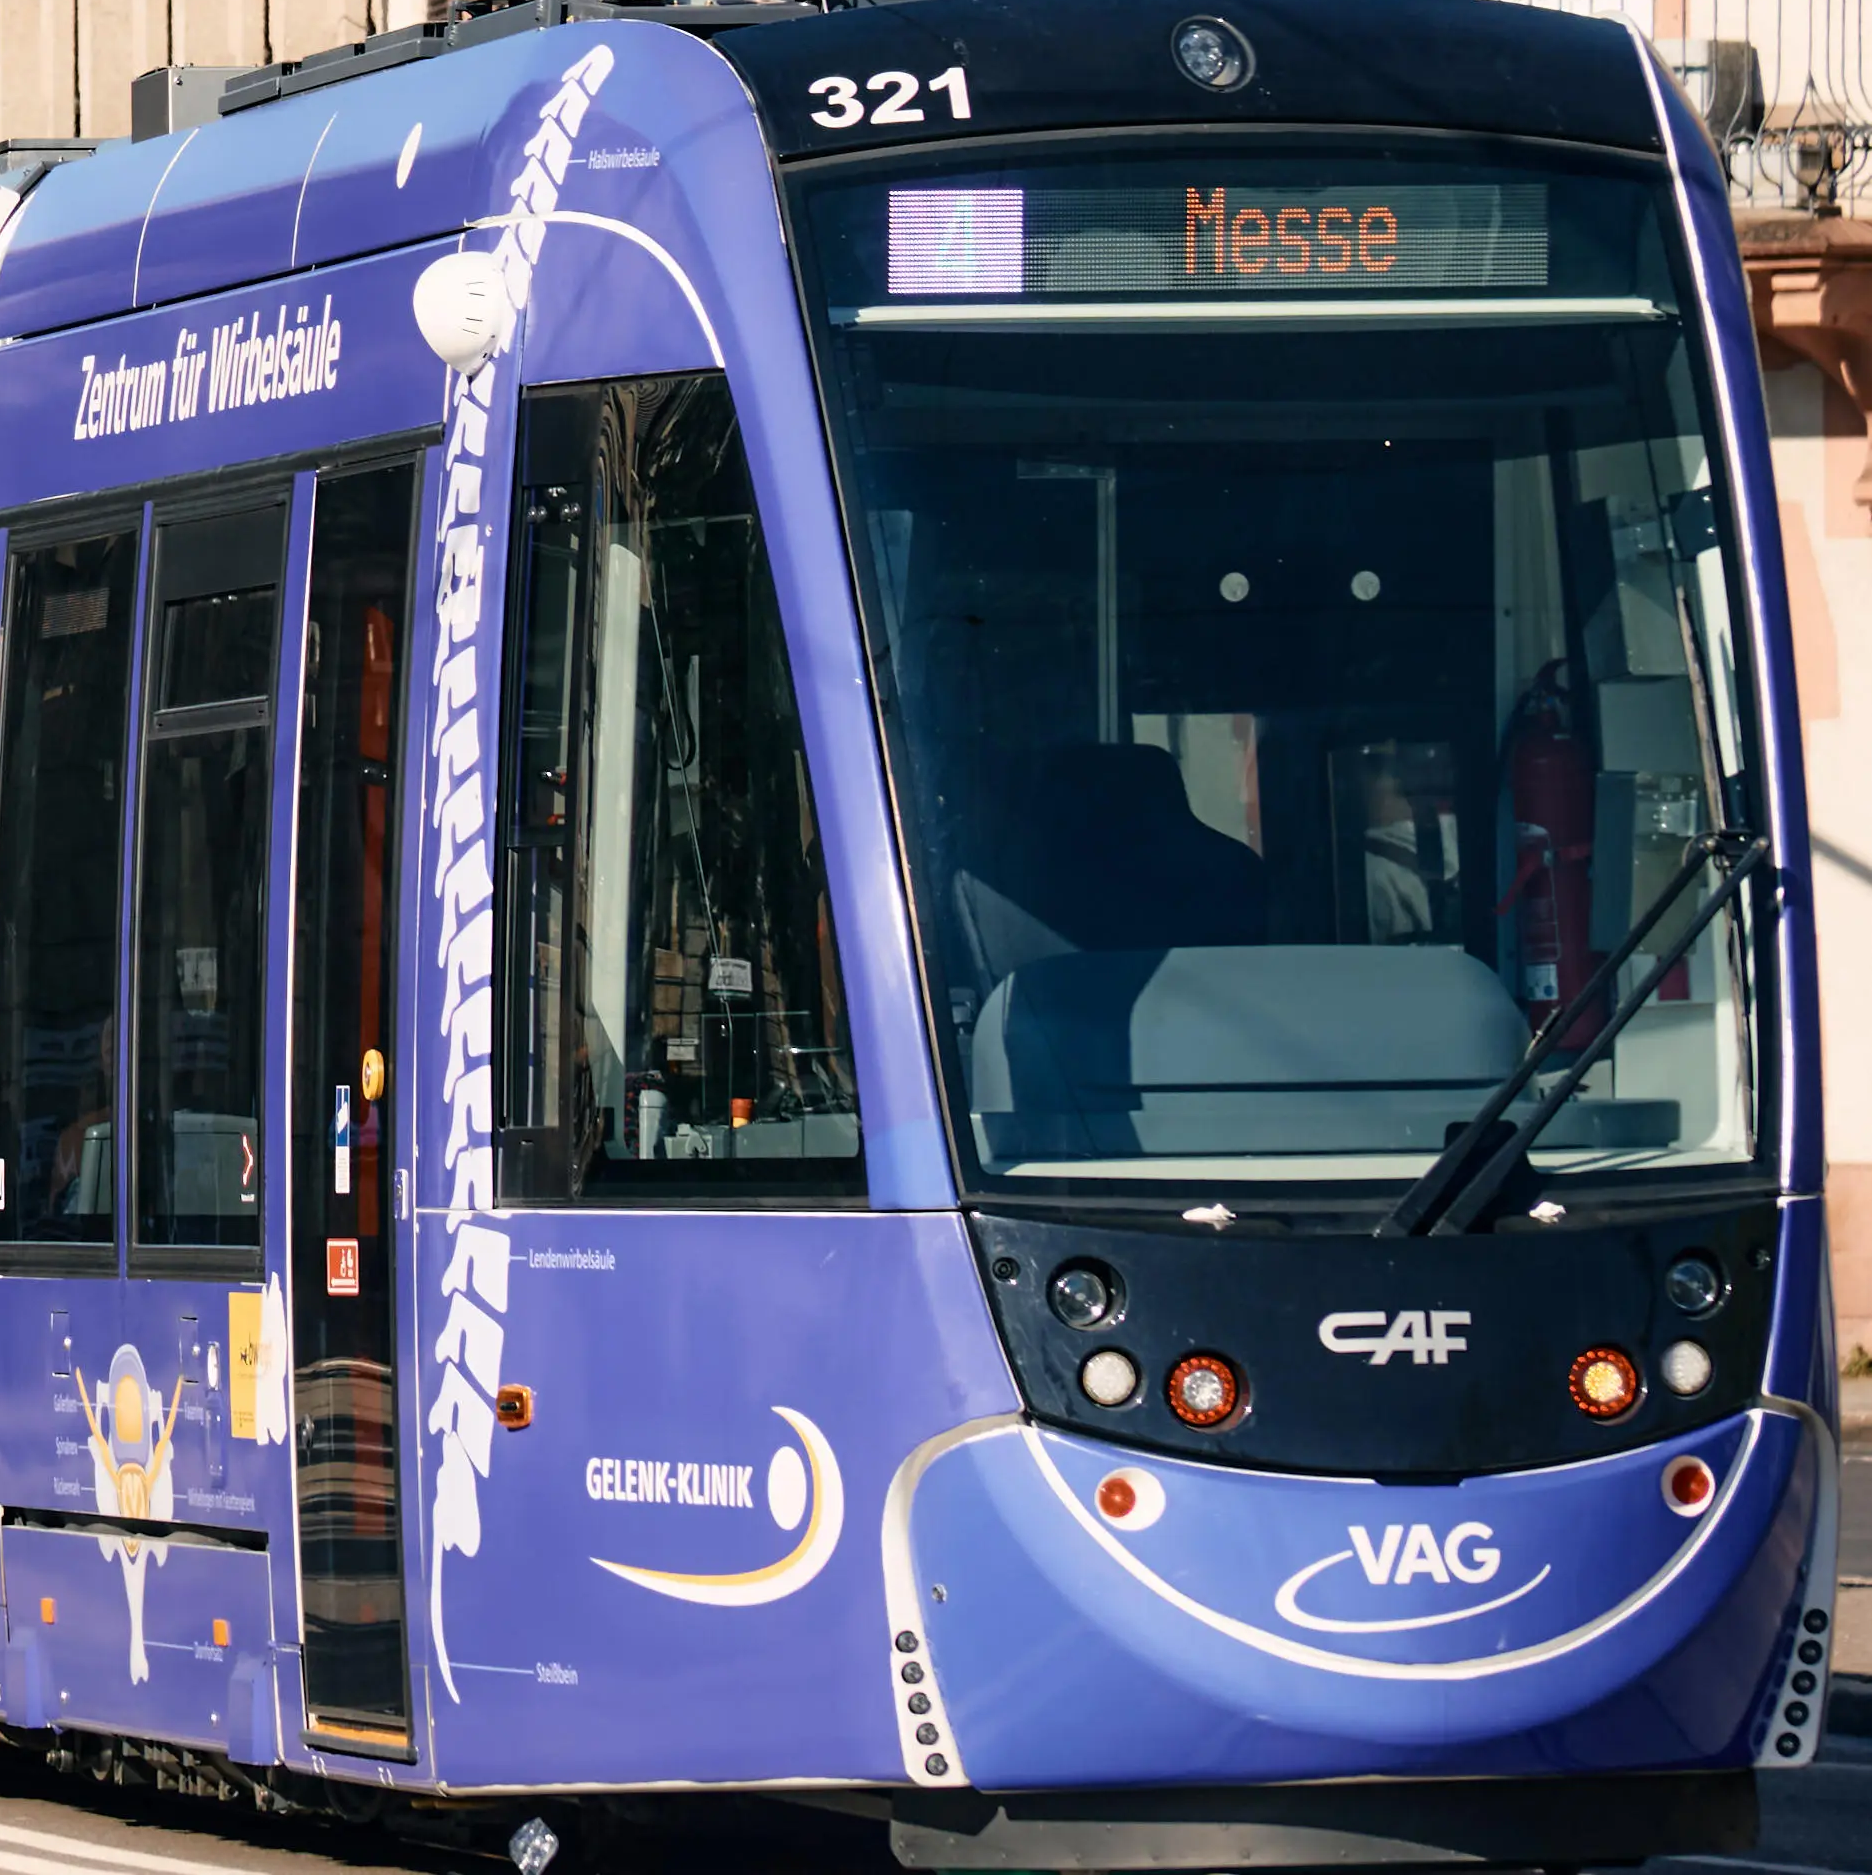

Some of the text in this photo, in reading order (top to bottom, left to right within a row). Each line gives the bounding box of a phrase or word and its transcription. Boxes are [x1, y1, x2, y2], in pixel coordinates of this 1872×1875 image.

[807, 66, 972, 129] 321
[587, 146, 660, 170] Halswirbelsäule
[1184, 186, 1398, 275] Messe
[73, 294, 341, 441] Zentrum für Wirbelsäule
[528, 1247, 616, 1271] Lendenwirbelsäule
[1318, 1310, 1472, 1365] CAF
[586, 1456, 754, 1509] GELENK-KLINIK
[1347, 1521, 1502, 1585] VAG
[535, 1661, 579, 1686] Steißbein
